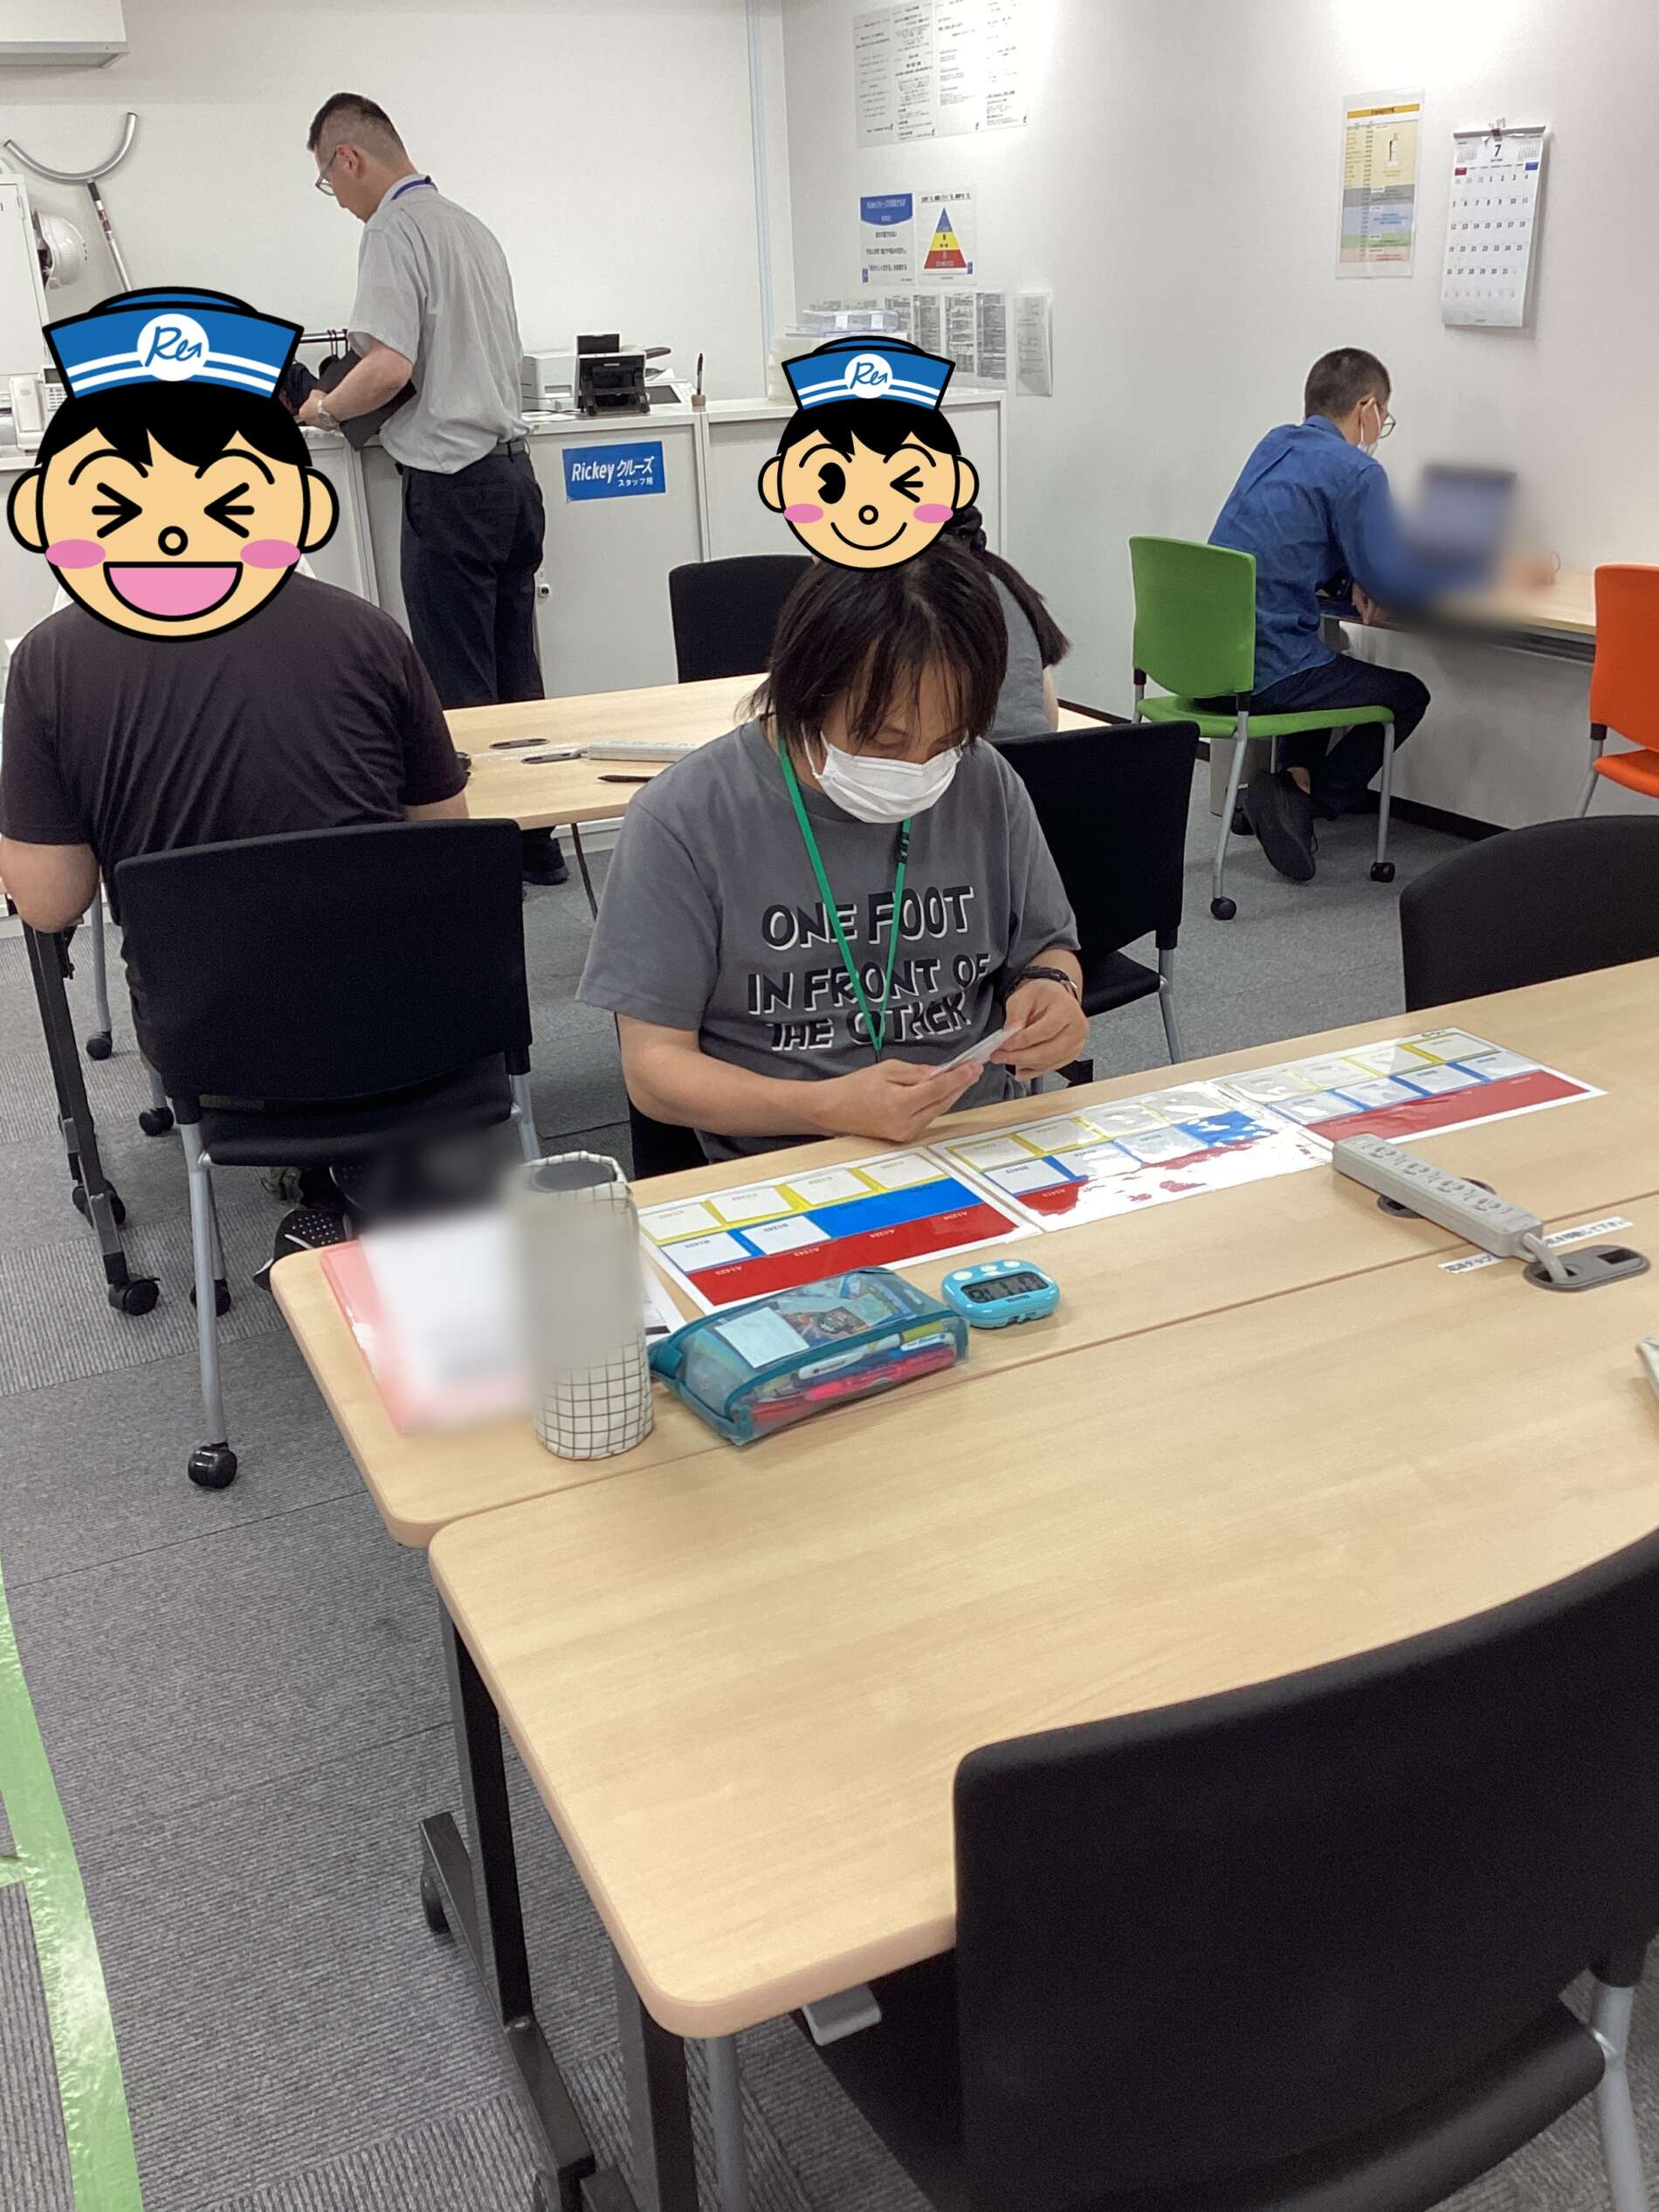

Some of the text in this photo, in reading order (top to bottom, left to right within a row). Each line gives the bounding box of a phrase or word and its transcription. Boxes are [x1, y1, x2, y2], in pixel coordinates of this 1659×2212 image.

[1495, 144, 1501, 157] 7
[571, 456, 655, 483] Rickey クルーズ
[761, 885, 974, 951] ONE FOOT
[747, 953, 991, 1016] IN FRONT OF
[767, 1017, 834, 1051] THE
